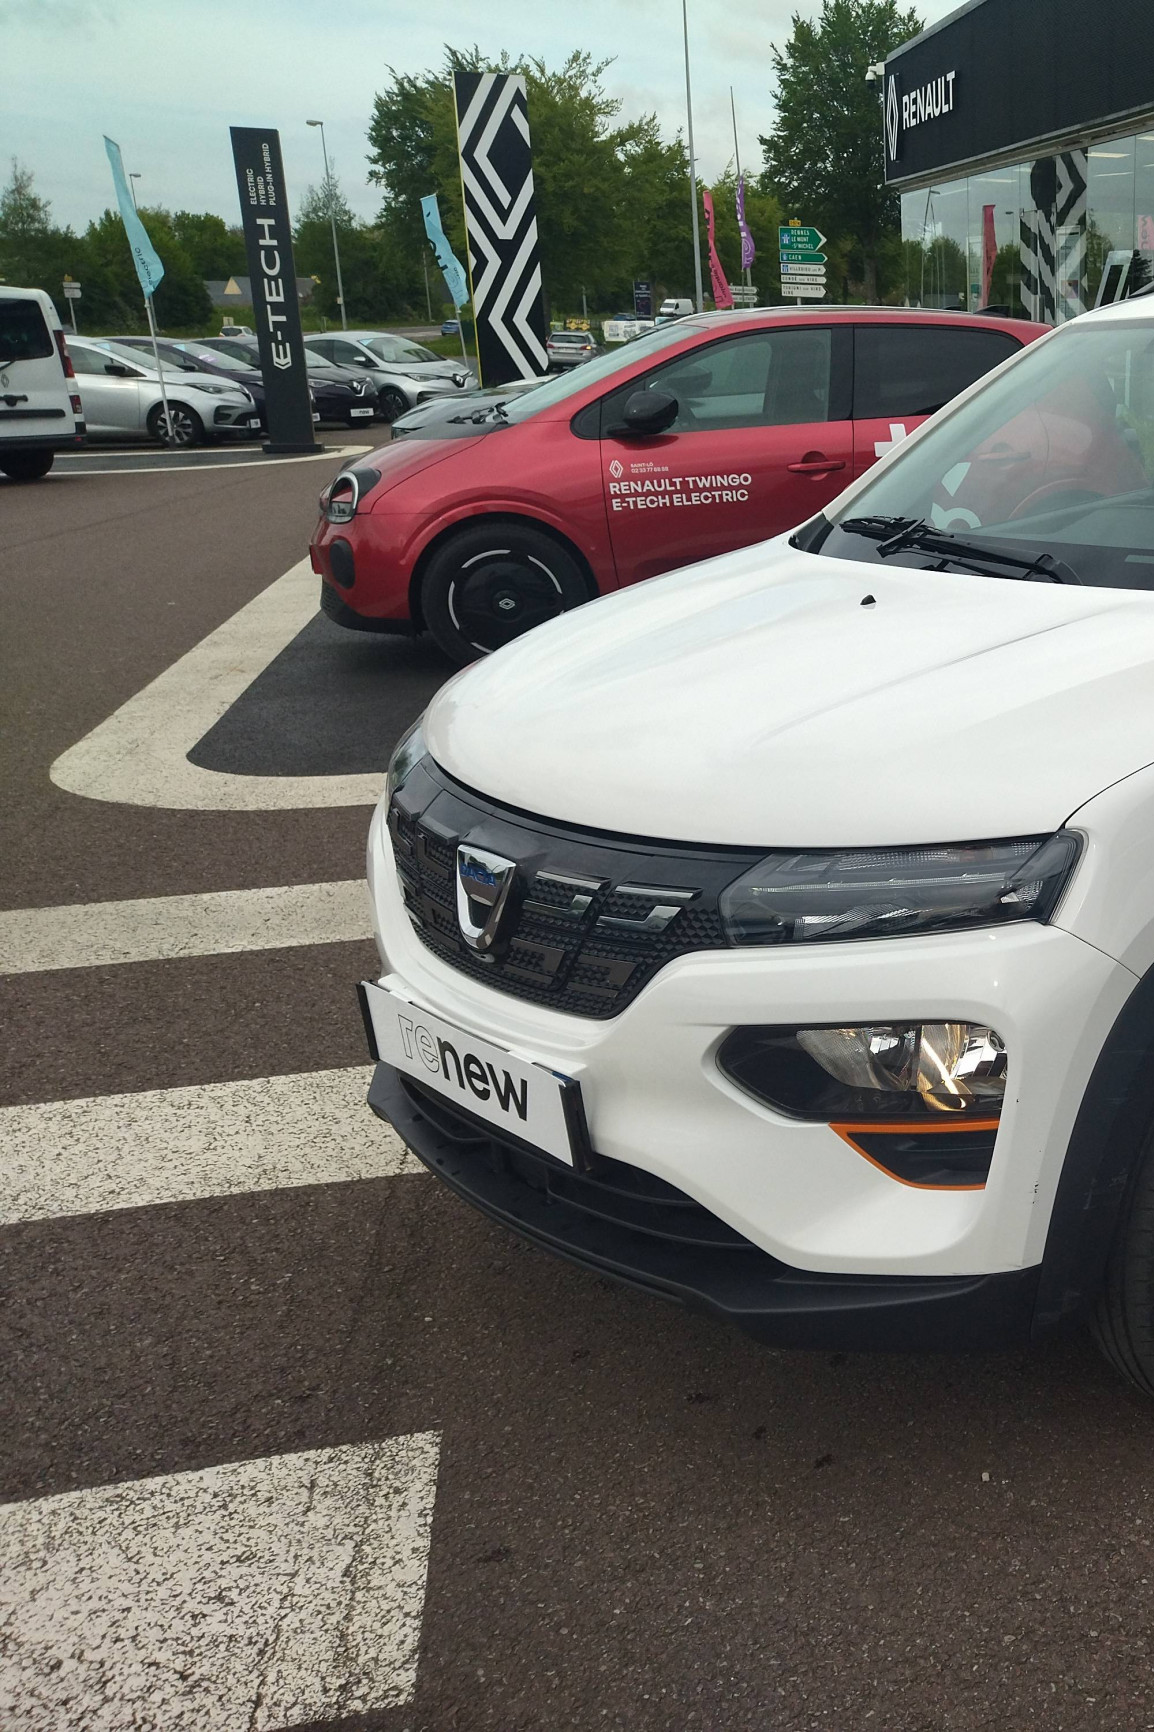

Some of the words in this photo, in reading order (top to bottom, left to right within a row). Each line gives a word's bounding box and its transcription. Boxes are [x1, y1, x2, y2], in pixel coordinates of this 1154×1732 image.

[902, 70, 956, 130] RENAULT
[262, 144, 272, 172] HYBRID
[246, 168, 258, 205] ELECTRIC
[257, 176, 267, 206] HYBRID
[266, 174, 276, 206] PLUG-IN
[256, 218, 292, 370] E-TECH
[609, 477, 683, 495] RENAULT
[685, 473, 752, 489] TWINGO
[612, 495, 670, 511] E-TECH
[672, 489, 749, 506] ELECTRIC
[398, 1014, 528, 1122] renew
